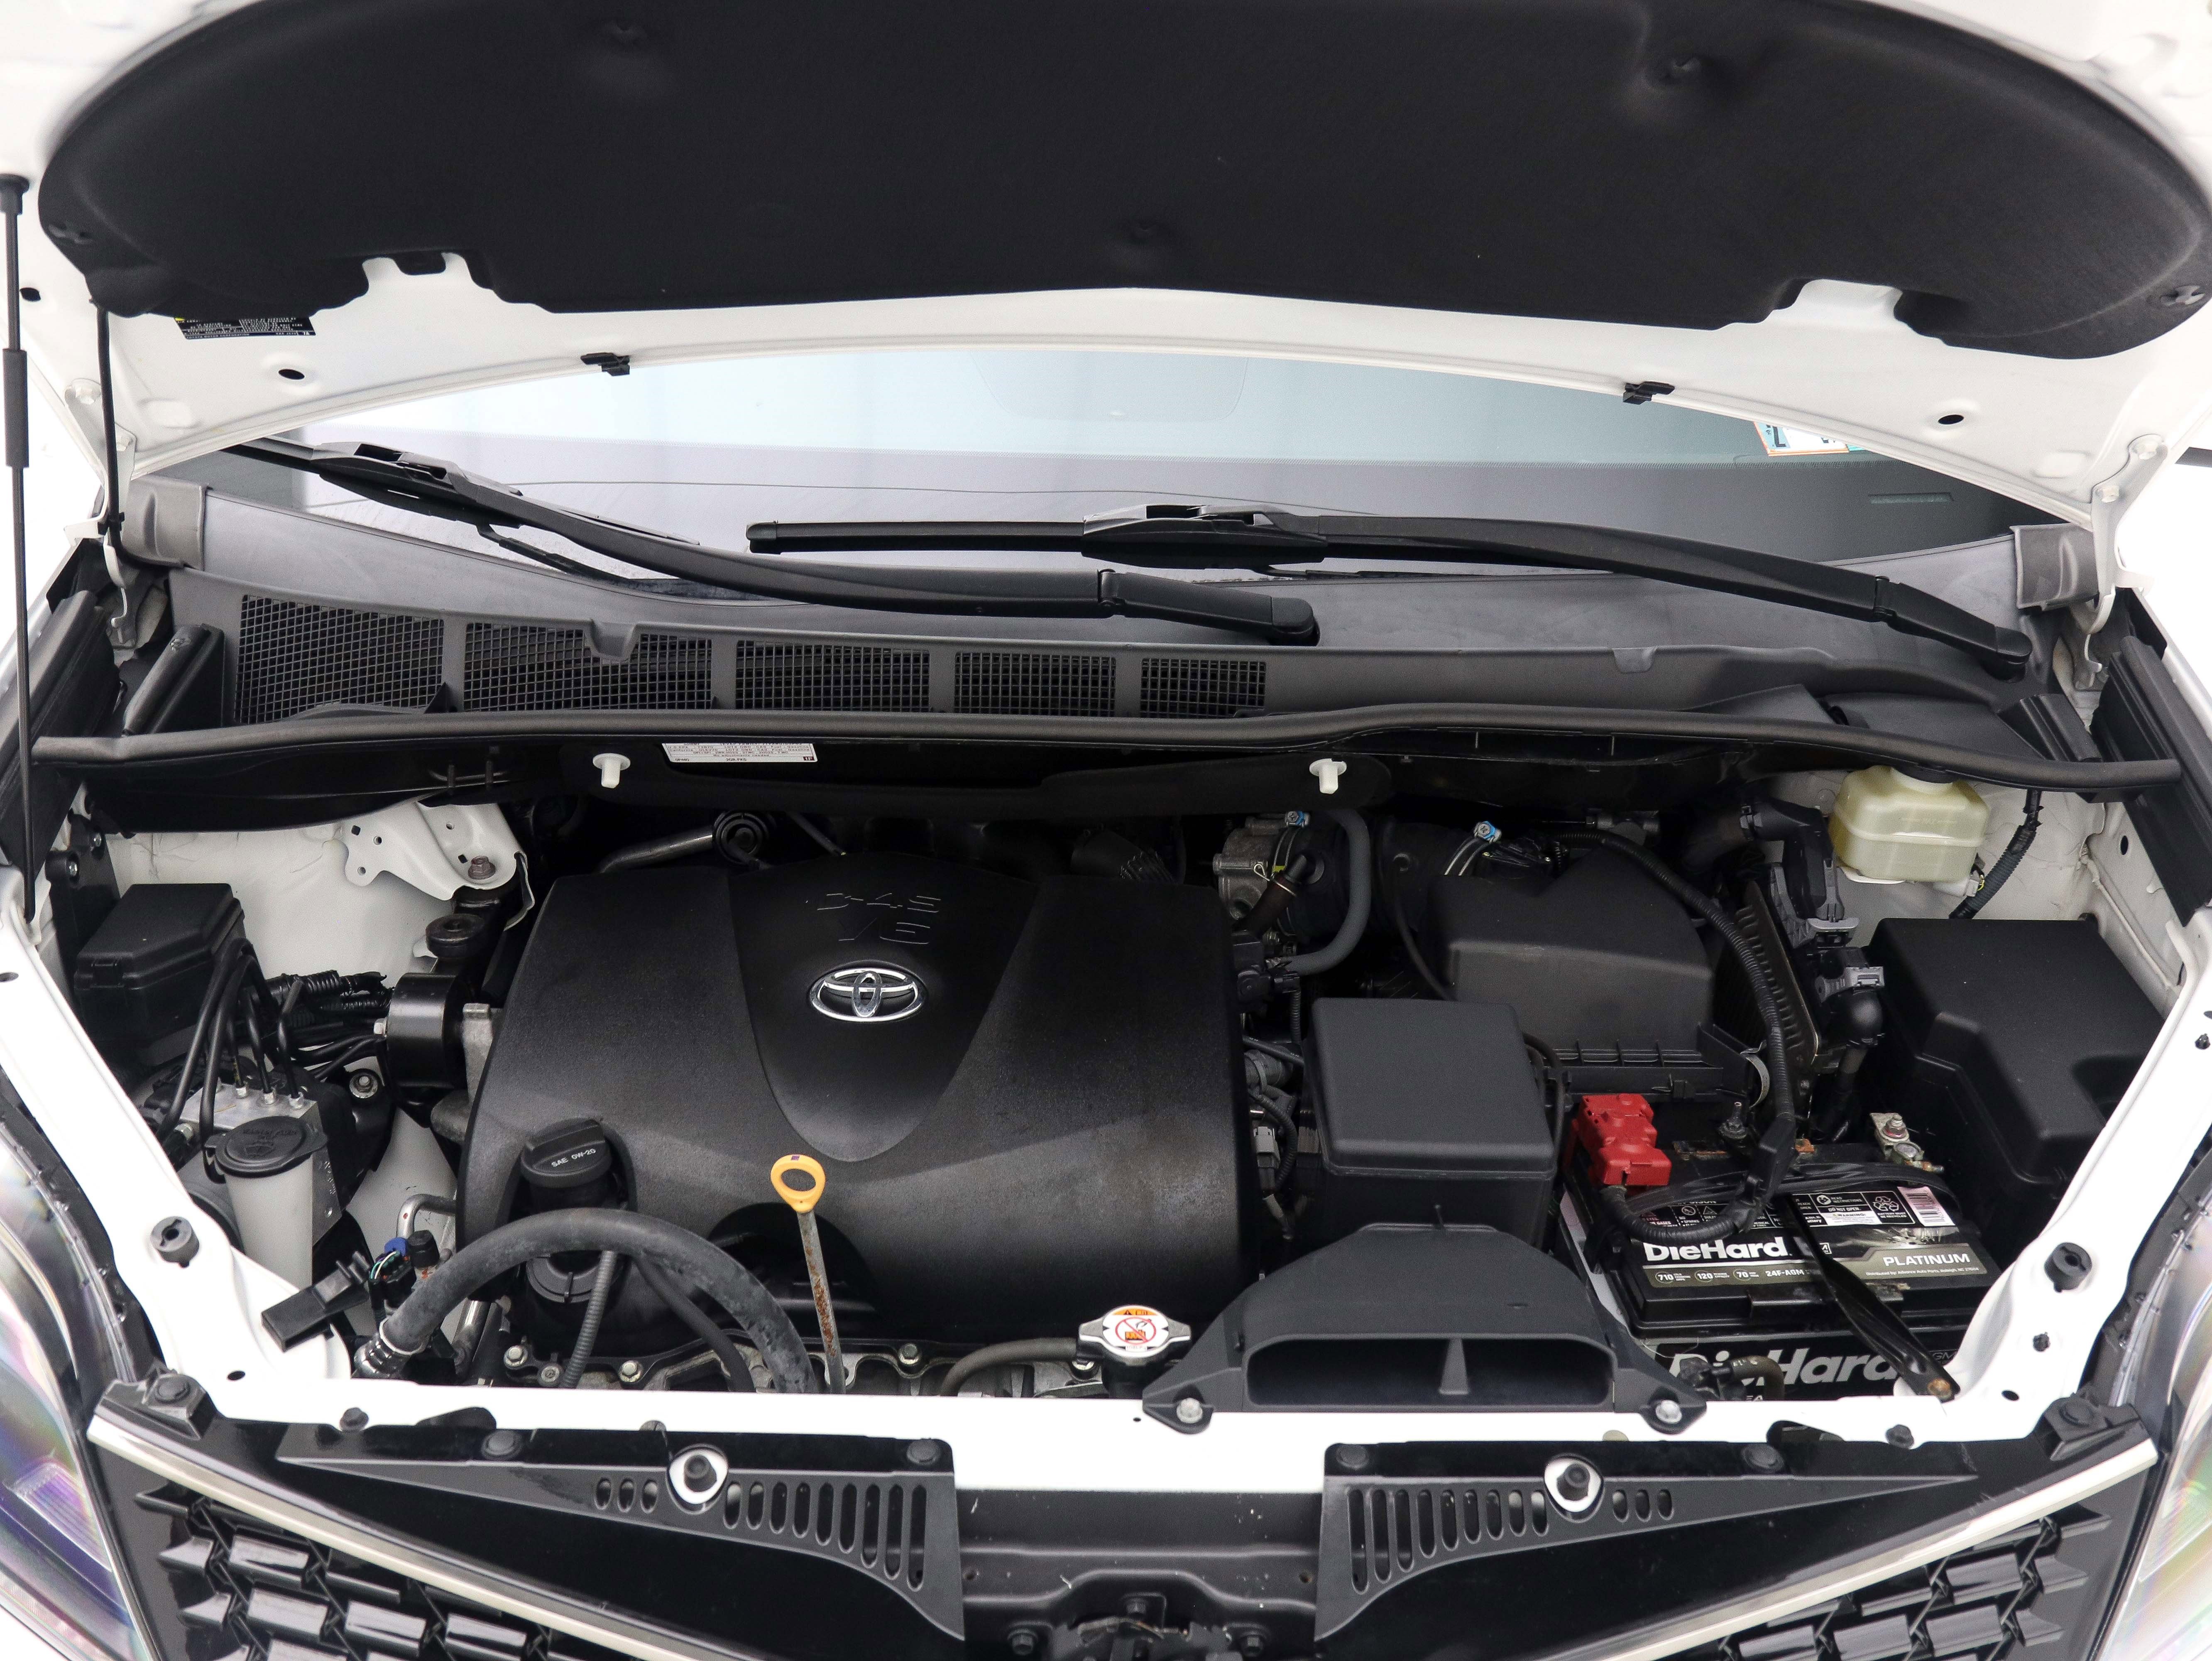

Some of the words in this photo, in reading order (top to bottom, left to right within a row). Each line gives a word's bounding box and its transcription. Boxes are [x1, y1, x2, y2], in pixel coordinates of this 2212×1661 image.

[551, 1157, 568, 1167] SAE
[1643, 1237, 1788, 1261] DieHard
[1883, 1253, 1970, 1267] PLATINUM
[1658, 1273, 1674, 1281] 710
